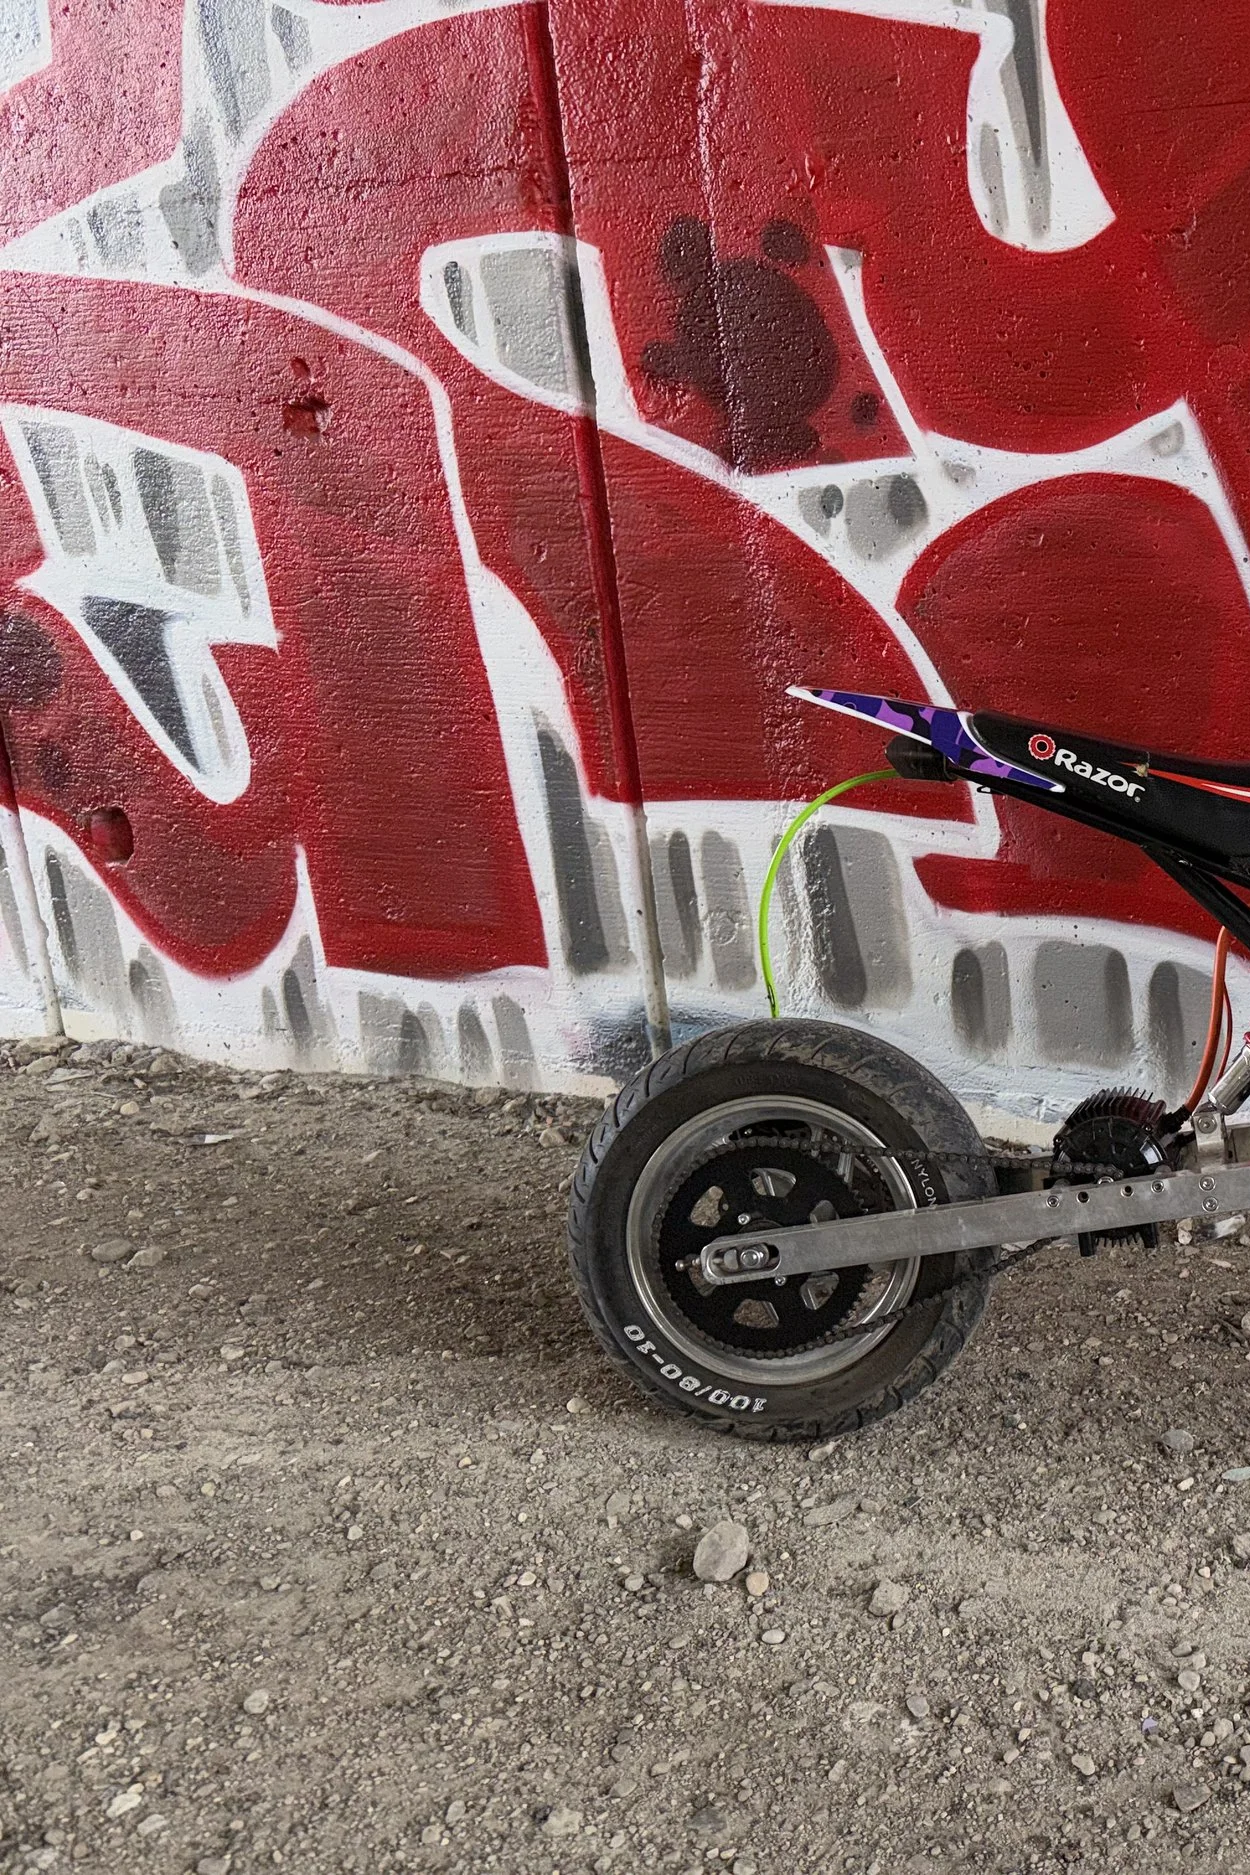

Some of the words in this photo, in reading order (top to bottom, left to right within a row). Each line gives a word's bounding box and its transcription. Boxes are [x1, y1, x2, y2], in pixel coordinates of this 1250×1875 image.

[1054, 747, 1146, 798] Razor
[910, 1158, 939, 1210] NYLON
[623, 1324, 768, 1413] 100/80-10
